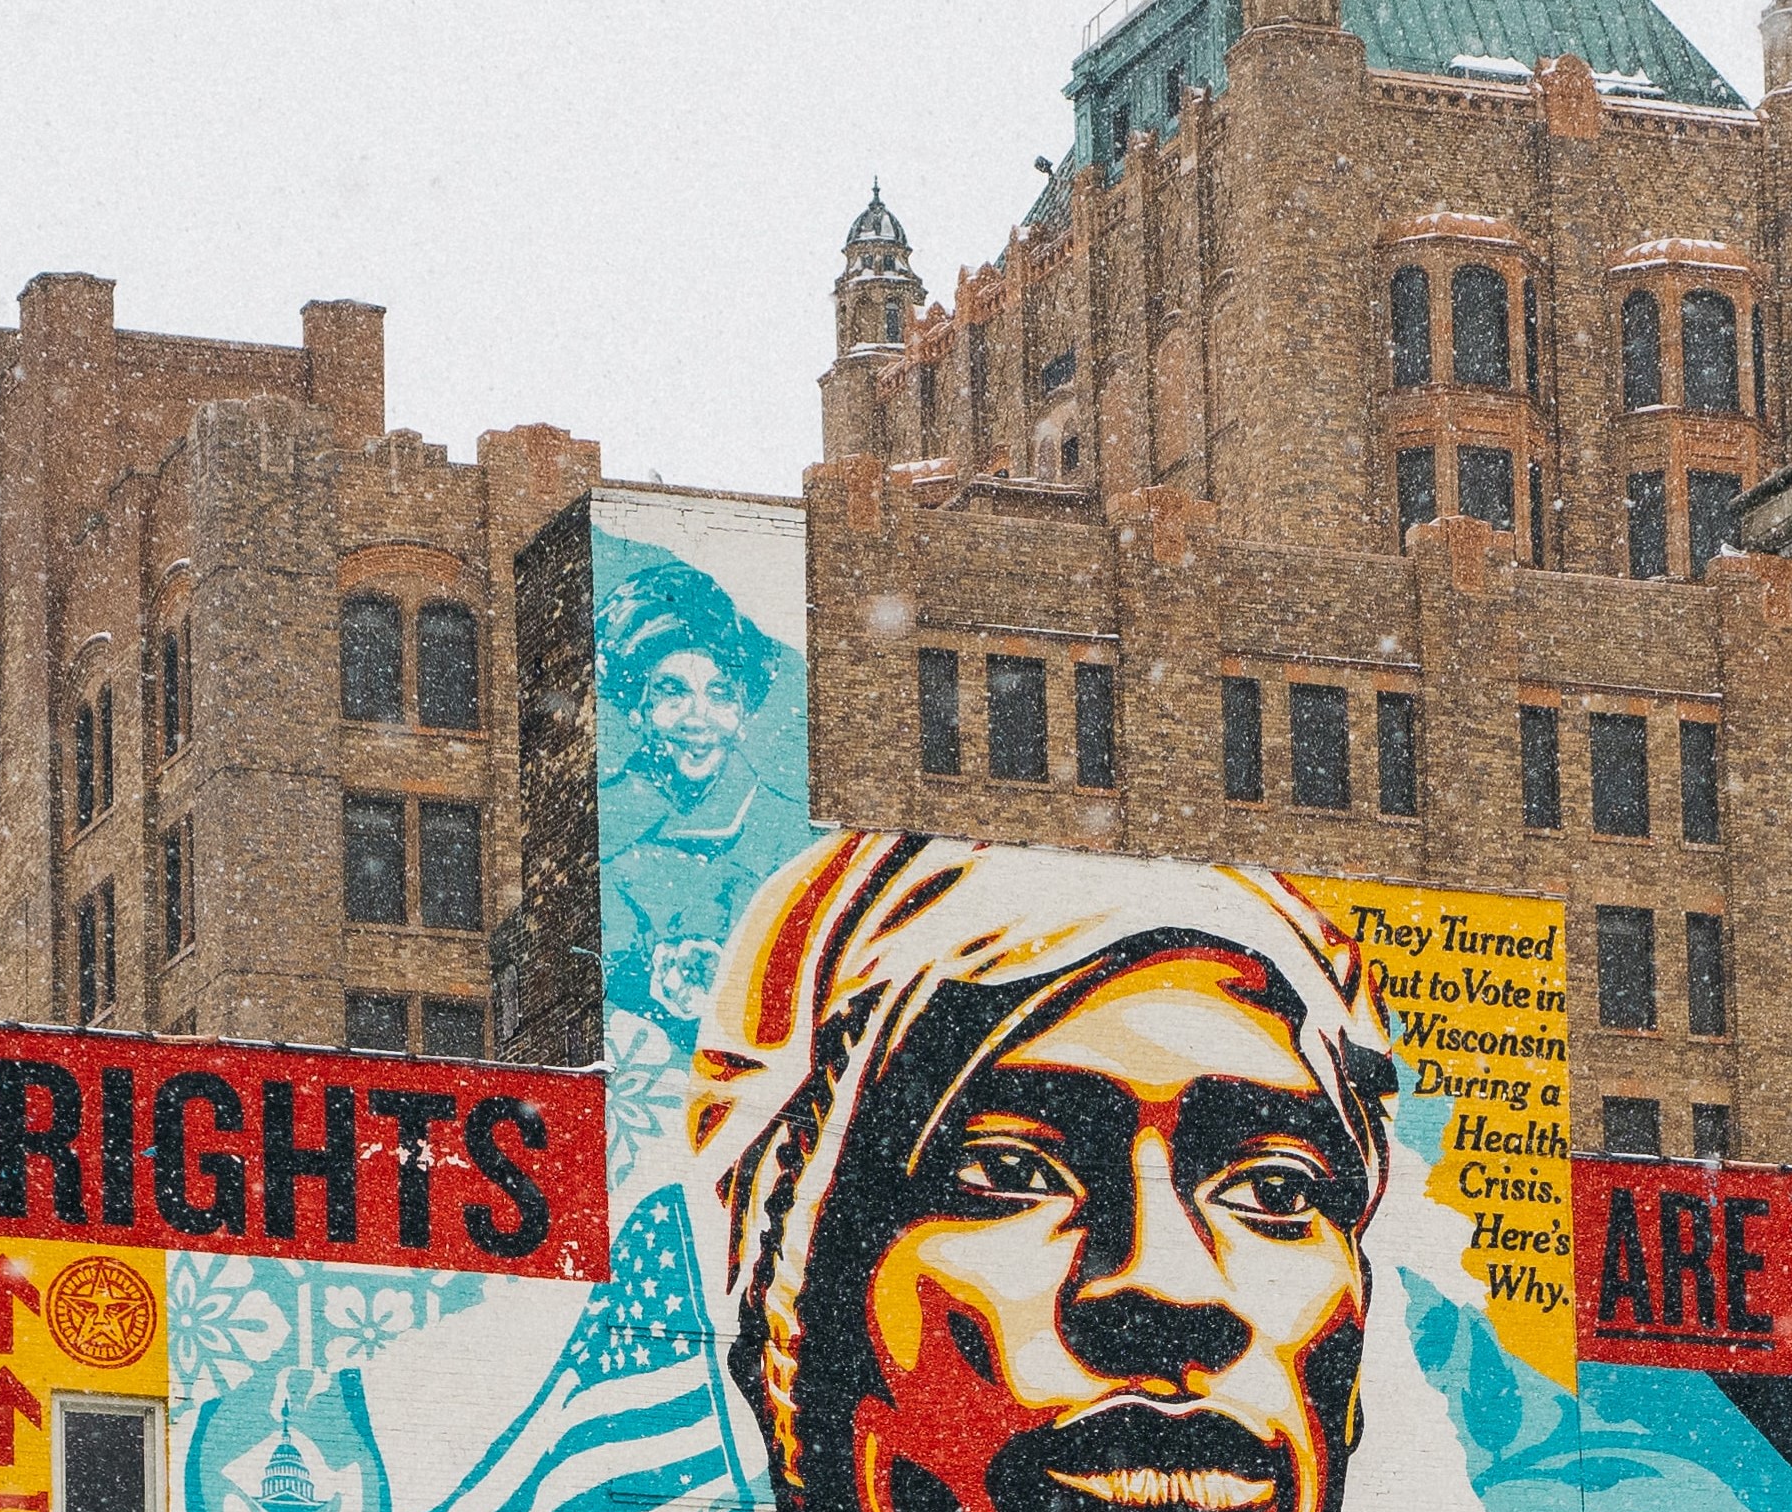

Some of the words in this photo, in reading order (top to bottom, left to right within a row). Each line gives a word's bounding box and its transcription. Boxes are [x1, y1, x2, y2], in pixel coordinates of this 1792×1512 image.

[1350, 905, 1432, 957] They
[1440, 914, 1557, 962] Turned
[1368, 958, 1423, 1000] Out
[1429, 971, 1461, 1003] to
[1462, 967, 1530, 1009] Vote
[1537, 976, 1566, 1013] in
[1397, 1010, 1567, 1061] Wisconsin
[1412, 1058, 1531, 1111] During
[1540, 1083, 1561, 1107] a
[1452, 1115, 1568, 1158] Health
[1458, 1161, 1561, 1205] Crisis.
[1470, 1212, 1570, 1256] Here's
[1599, 1187, 1772, 1336] ARE
[1487, 1263, 1569, 1313] Why.
